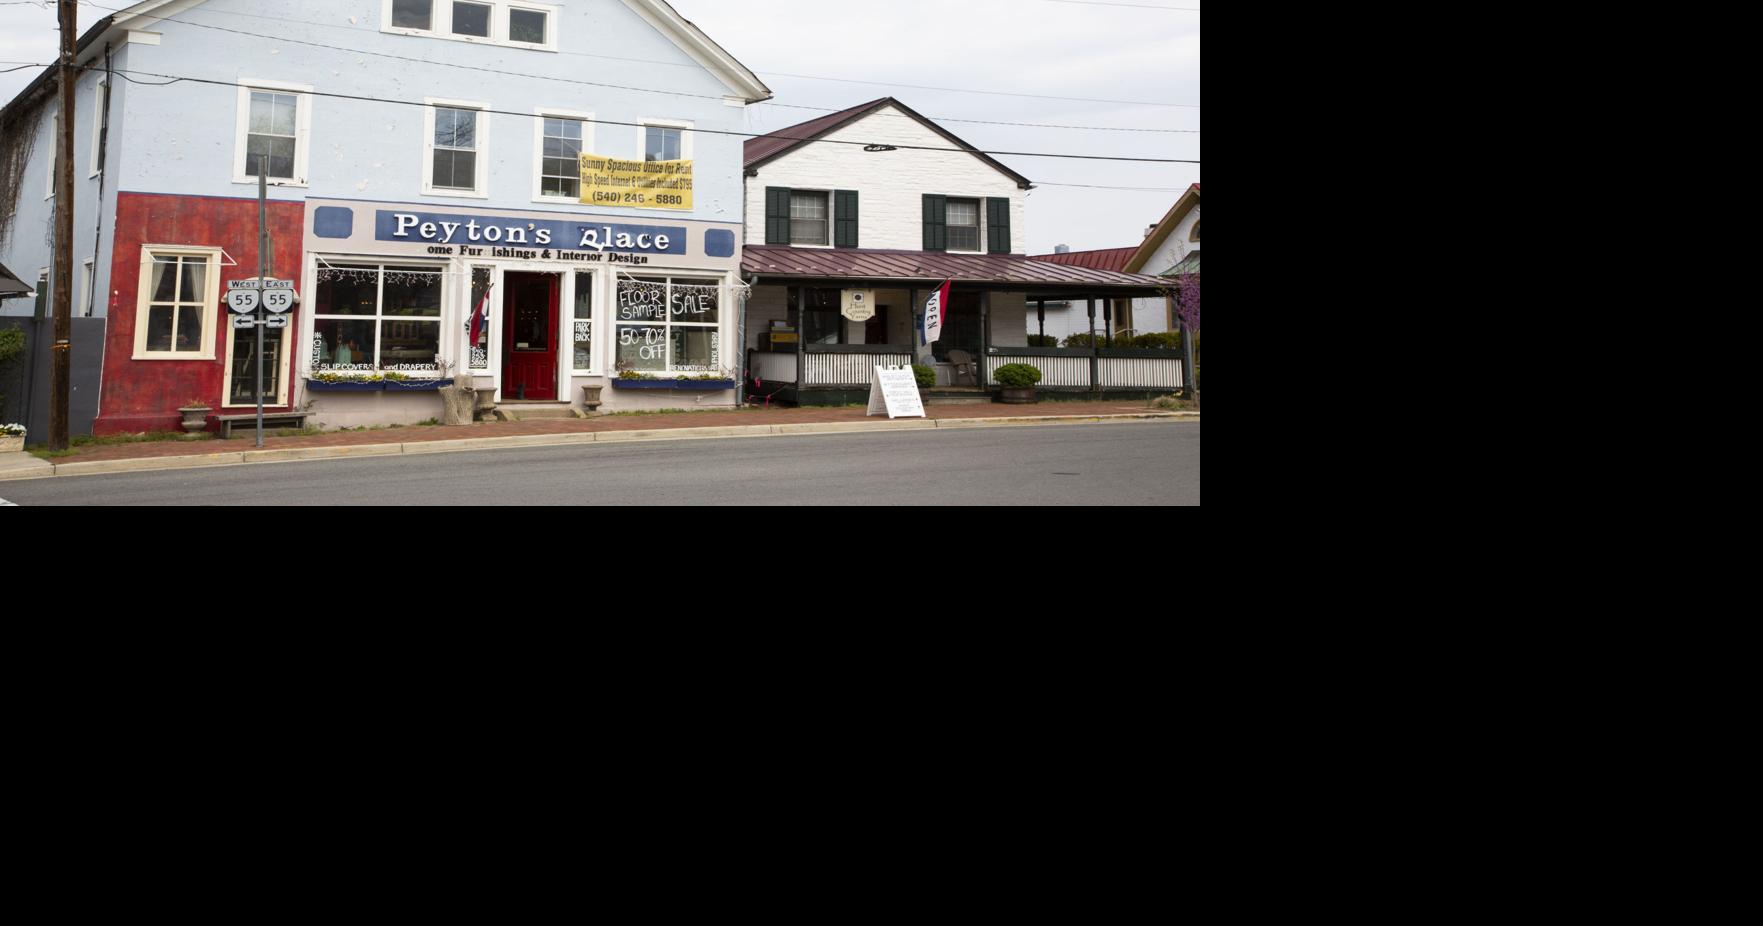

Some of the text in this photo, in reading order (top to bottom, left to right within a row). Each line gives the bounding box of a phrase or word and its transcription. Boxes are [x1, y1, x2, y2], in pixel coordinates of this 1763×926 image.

[581, 156, 605, 171] Sunny
[607, 159, 641, 173] Spacious
[643, 161, 664, 173] Office
[664, 162, 675, 174] for
[581, 172, 593, 187] High
[594, 173, 610, 188] Speed
[610, 175, 631, 187] Internet
[656, 177, 679, 189] Included
[592, 191, 621, 203] (540)
[624, 193, 645, 203] 246
[656, 194, 682, 205] 5880
[393, 213, 670, 252] Peyton's Place
[541, 249, 551, 259] &
[557, 250, 602, 262] Interior
[608, 252, 648, 264] Design
[235, 294, 253, 306] 55
[269, 294, 287, 306] 55
[620, 290, 662, 307] FLOOR
[671, 294, 711, 315] SALE
[620, 304, 666, 320] SAMPLE
[575, 321, 590, 332] PARK
[575, 333, 591, 342] BACK
[619, 327, 665, 345] 50-70%
[640, 344, 665, 360] OFF
[320, 363, 341, 371] SLIP
[399, 363, 437, 371] DRAPERY
